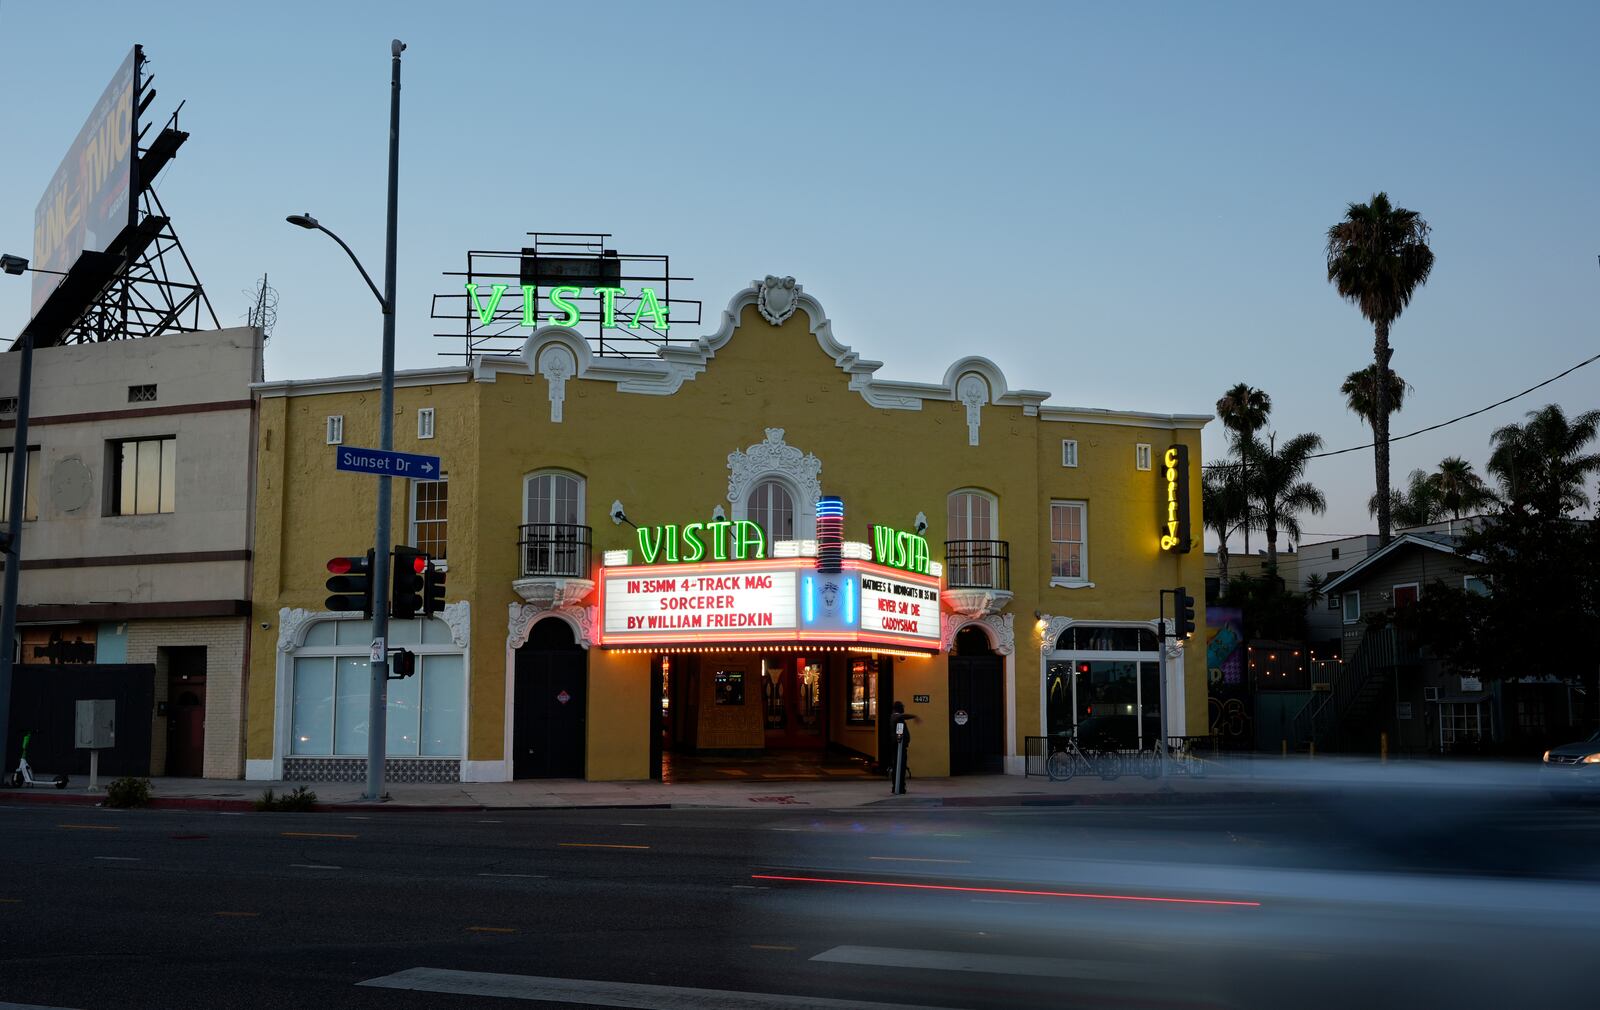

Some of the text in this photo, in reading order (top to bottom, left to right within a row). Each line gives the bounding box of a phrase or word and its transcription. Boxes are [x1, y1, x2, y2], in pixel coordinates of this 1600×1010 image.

[465, 283, 671, 330] VISTA
[343, 452, 411, 472] Sunset Dr
[637, 520, 767, 564] VISTA
[873, 524, 930, 574] VISTA
[627, 575, 772, 594] IN 35MM 4-TRACK MAG
[862, 578, 886, 592] MATINEES
[919, 589, 923, 599] IN
[660, 595, 735, 610] SORCERER
[878, 597, 920, 616] NEVER SAY DIE
[627, 612, 773, 630] BY WILLIAM FRIEDKIN
[881, 616, 918, 633] CADDYSHACK
